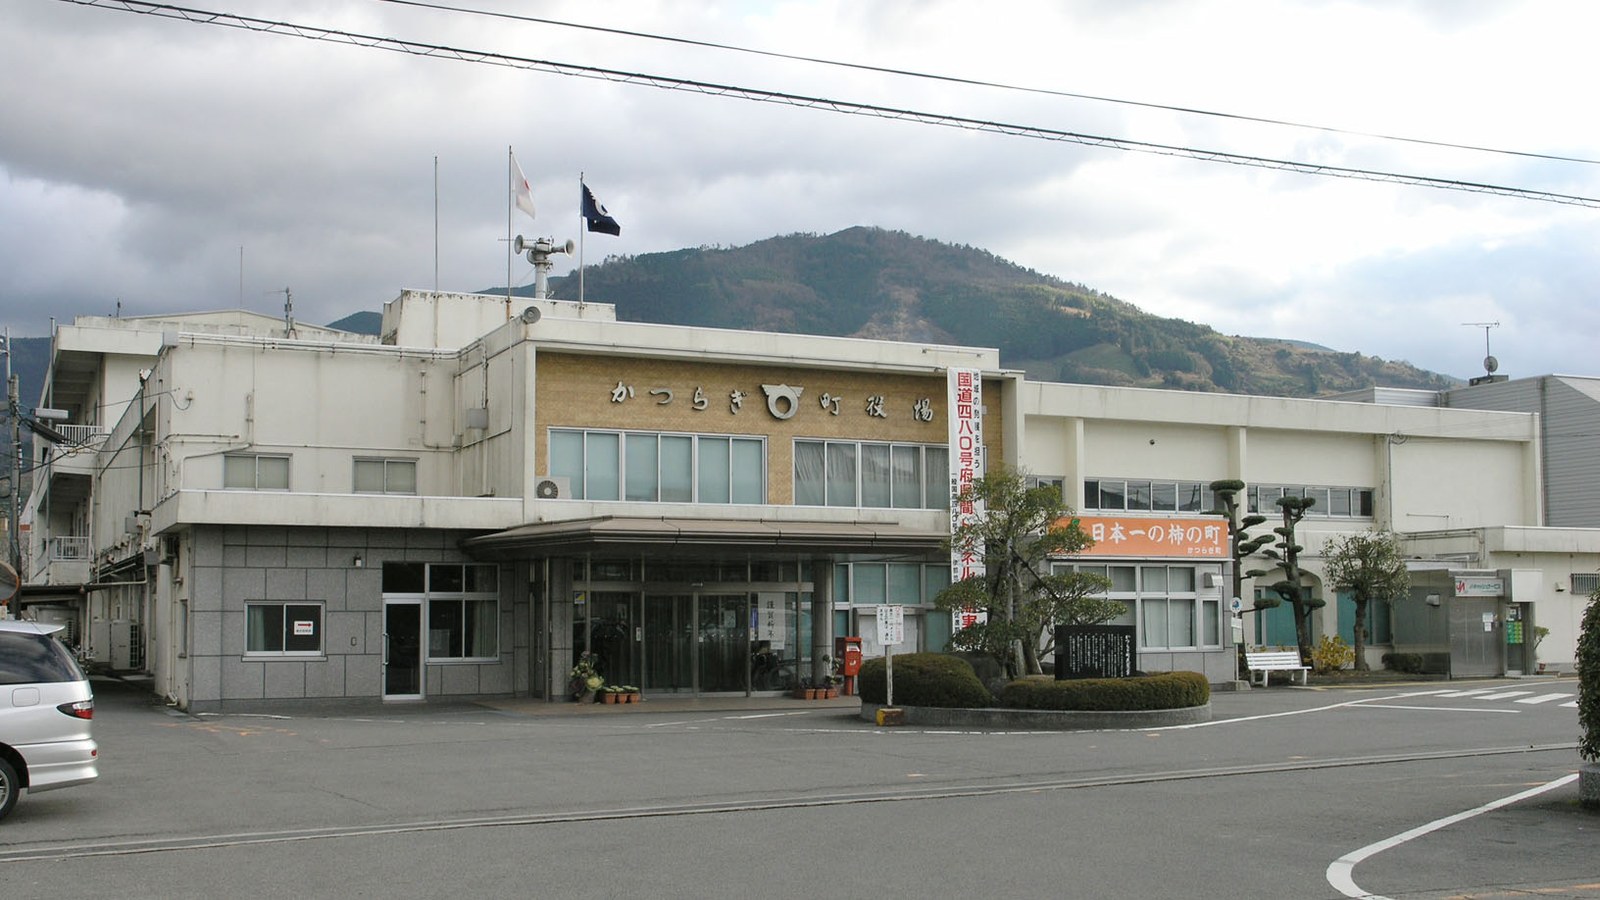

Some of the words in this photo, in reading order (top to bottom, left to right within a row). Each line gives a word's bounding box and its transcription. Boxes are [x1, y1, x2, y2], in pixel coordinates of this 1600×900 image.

[611, 381, 747, 414] かつらぎ
[819, 392, 934, 422] 町役場
[1092, 522, 1220, 546] 日本一の柿の町
